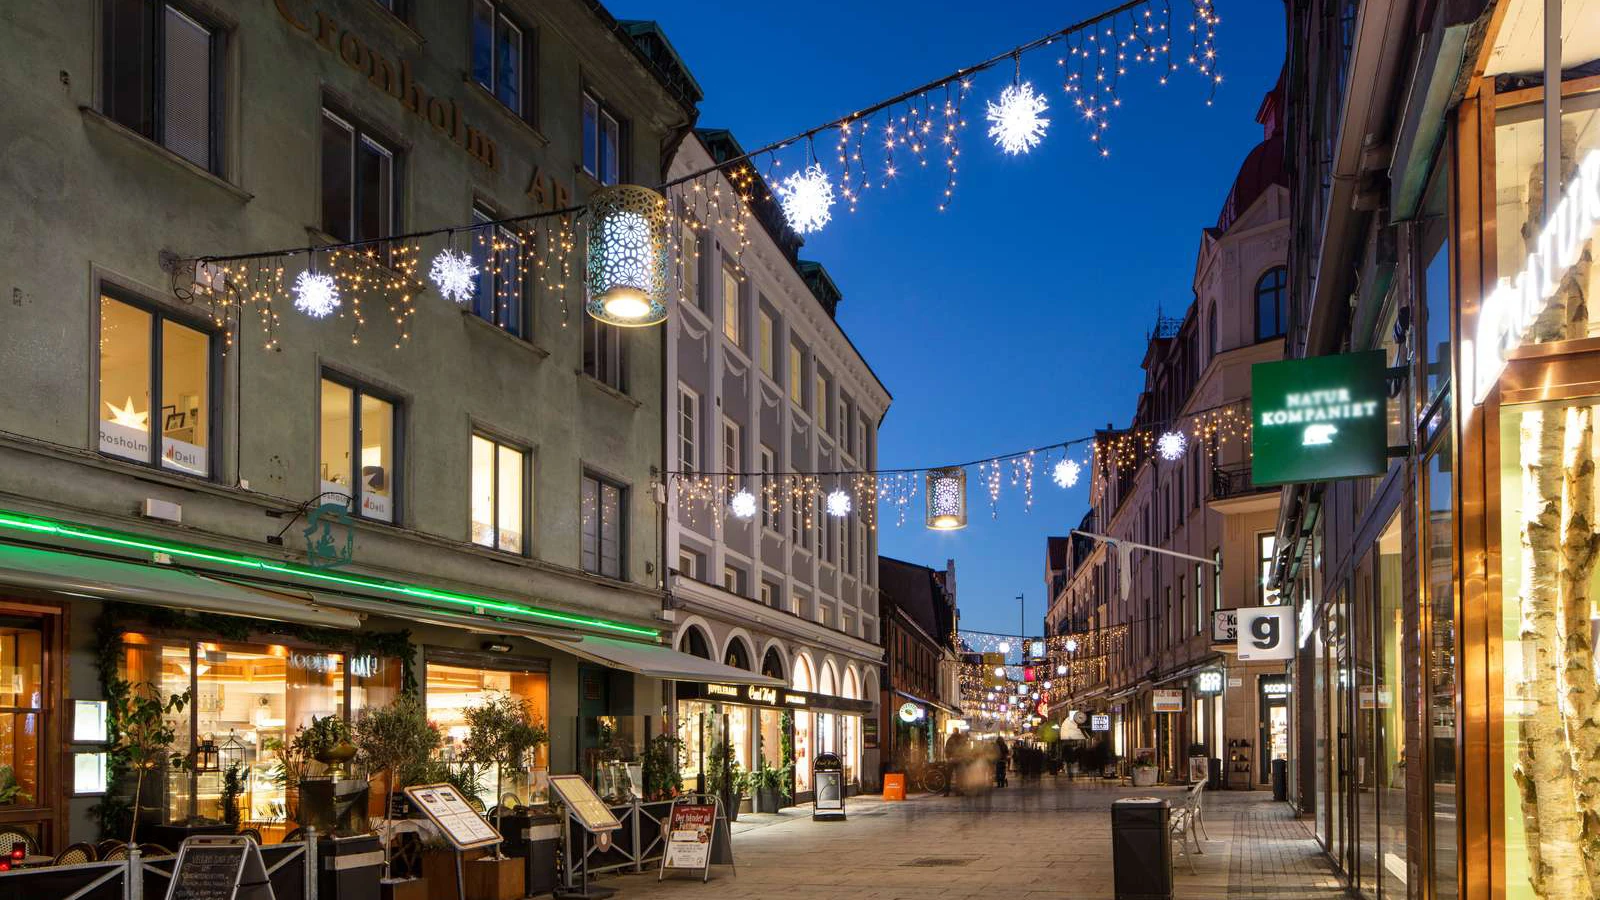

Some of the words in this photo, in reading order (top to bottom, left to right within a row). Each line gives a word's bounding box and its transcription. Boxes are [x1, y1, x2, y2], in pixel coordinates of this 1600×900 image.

[1285, 388, 1351, 409] NATUR
[1261, 401, 1378, 426] KOMPANIET
[98, 430, 148, 452] Rosholm
[175, 450, 195, 464] Dell
[1251, 616, 1280, 650] g
